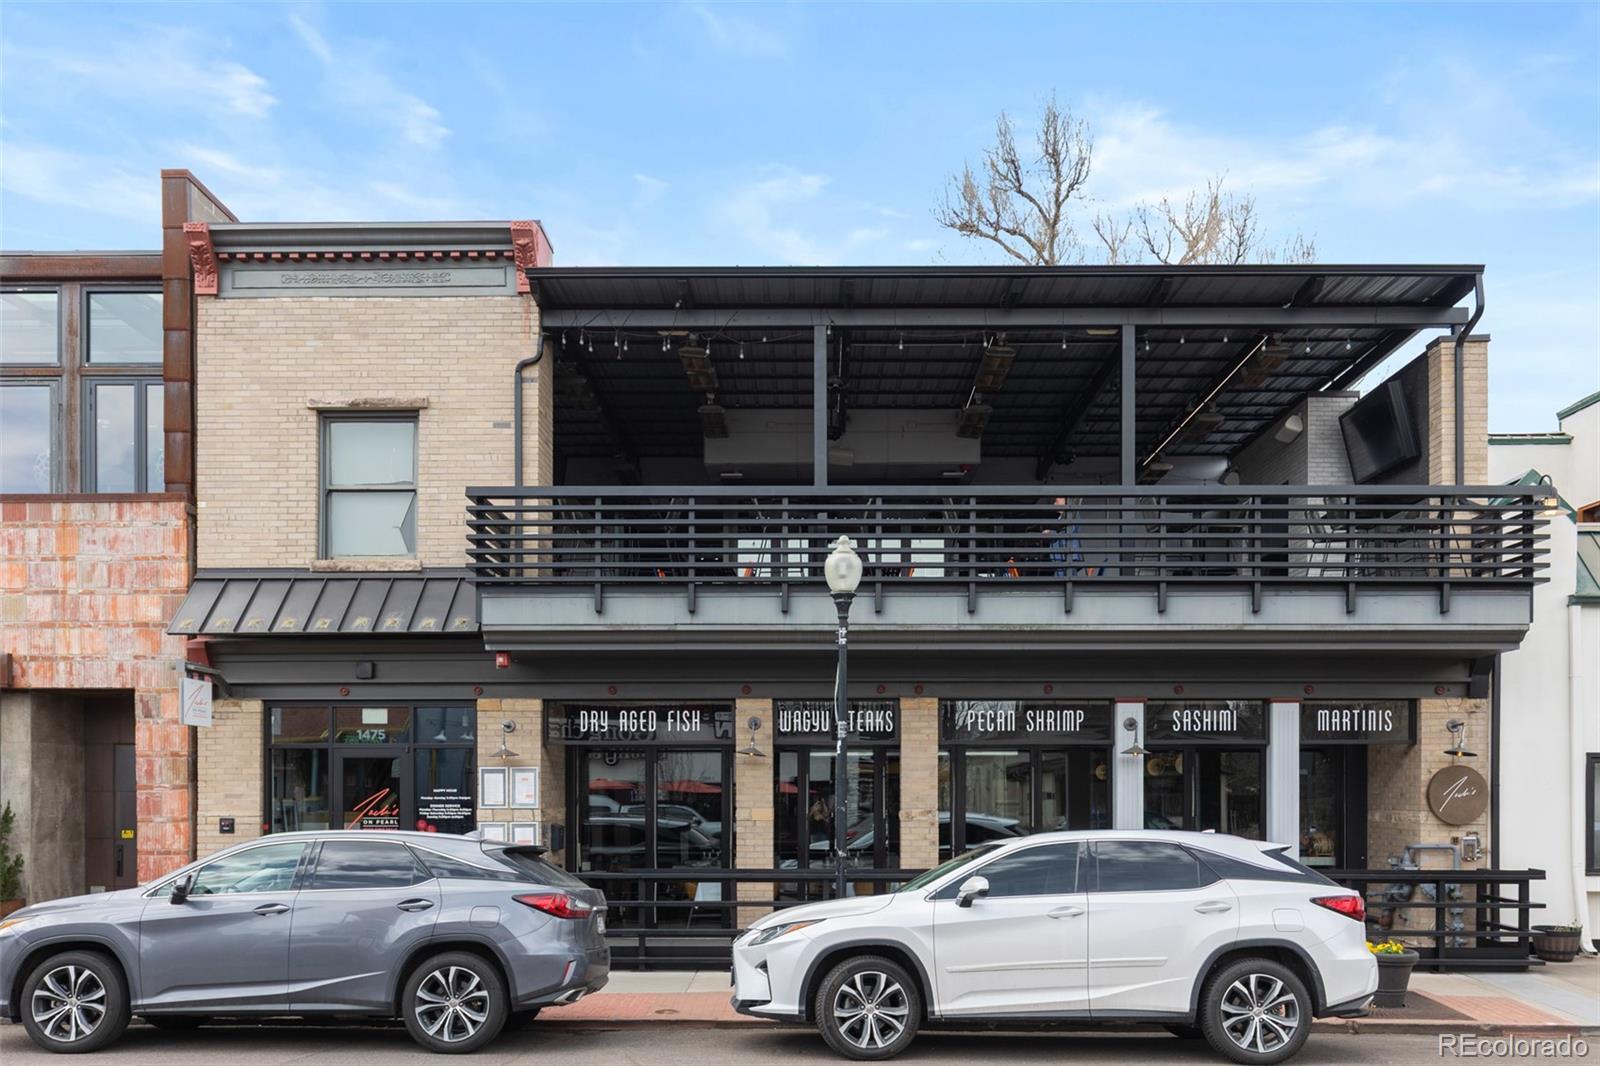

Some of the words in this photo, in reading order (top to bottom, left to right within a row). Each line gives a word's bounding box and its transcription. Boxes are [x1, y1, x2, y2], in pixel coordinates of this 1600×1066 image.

[580, 710, 608, 732] DRY
[619, 710, 657, 732] AGED
[667, 710, 700, 732] FISH
[779, 710, 830, 732] WAGYU
[847, 710, 893, 732] TEAKS
[967, 710, 1015, 732] PECAN
[1026, 710, 1084, 732] SHRIMP
[1172, 710, 1237, 732] SASHIMI
[1317, 709, 1393, 732] MARTINIS
[357, 729, 386, 741] 1475
